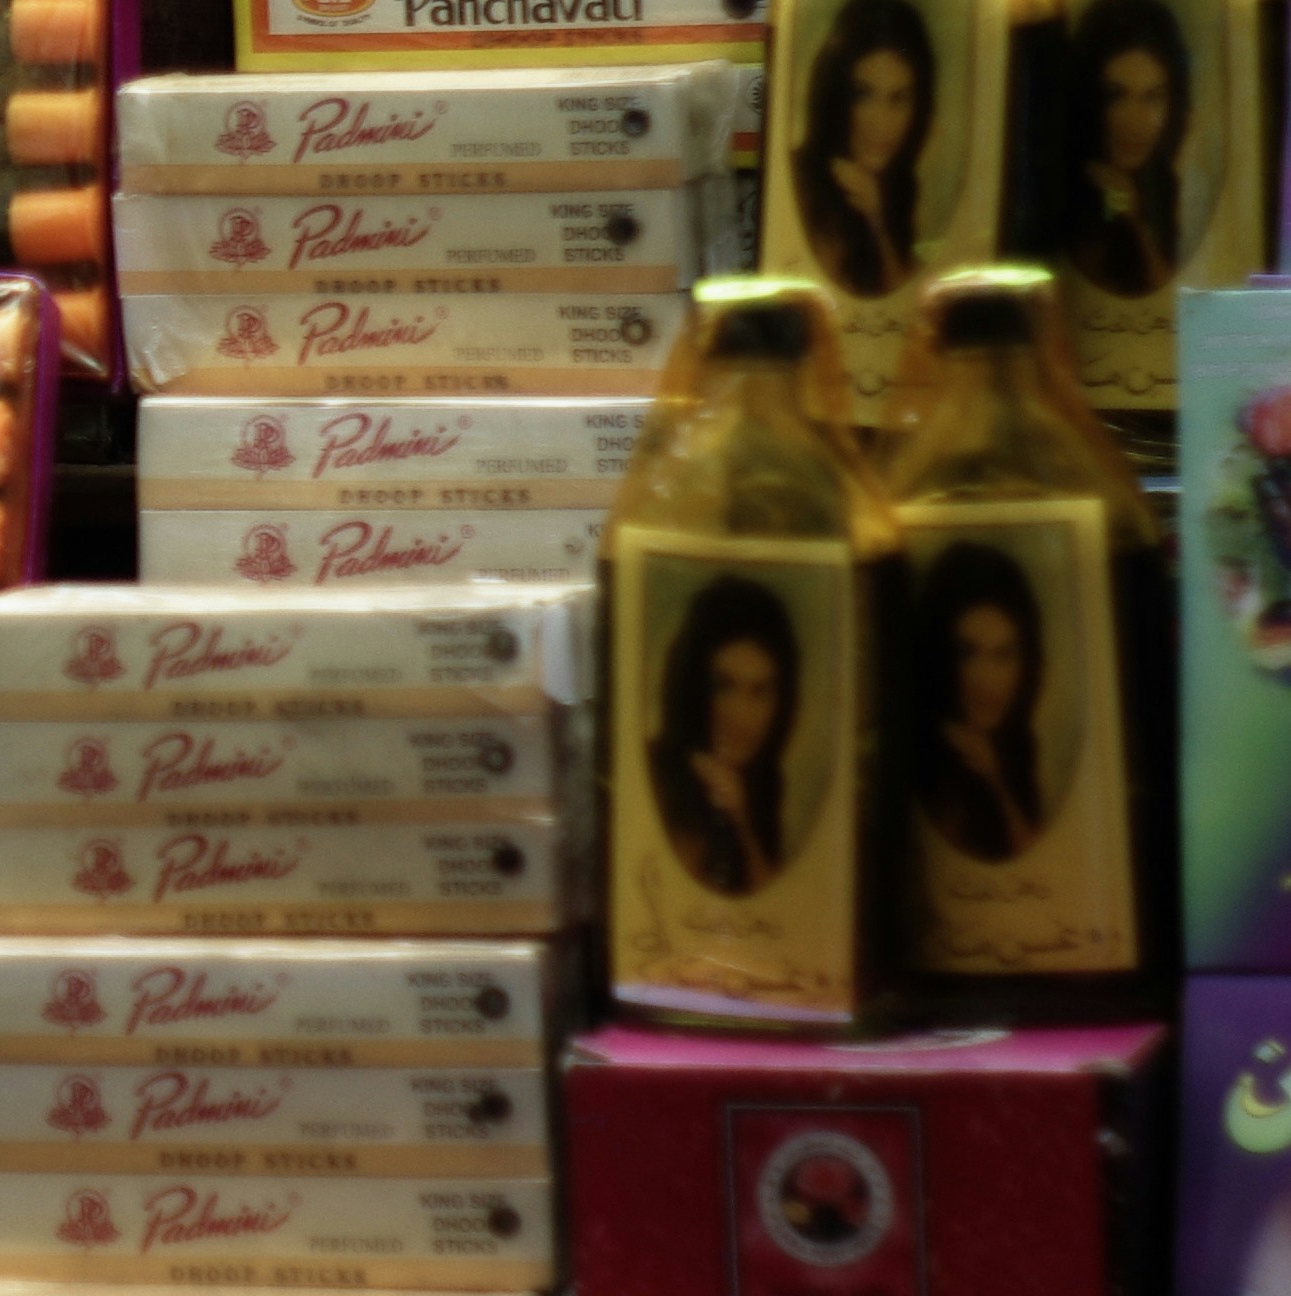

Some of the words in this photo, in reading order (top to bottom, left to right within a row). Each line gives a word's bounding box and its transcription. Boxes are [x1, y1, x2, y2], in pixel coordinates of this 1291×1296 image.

[293, 98, 440, 164] Padmini
[315, 413, 458, 478] Padmini
[127, 966, 278, 1035] Padmini
